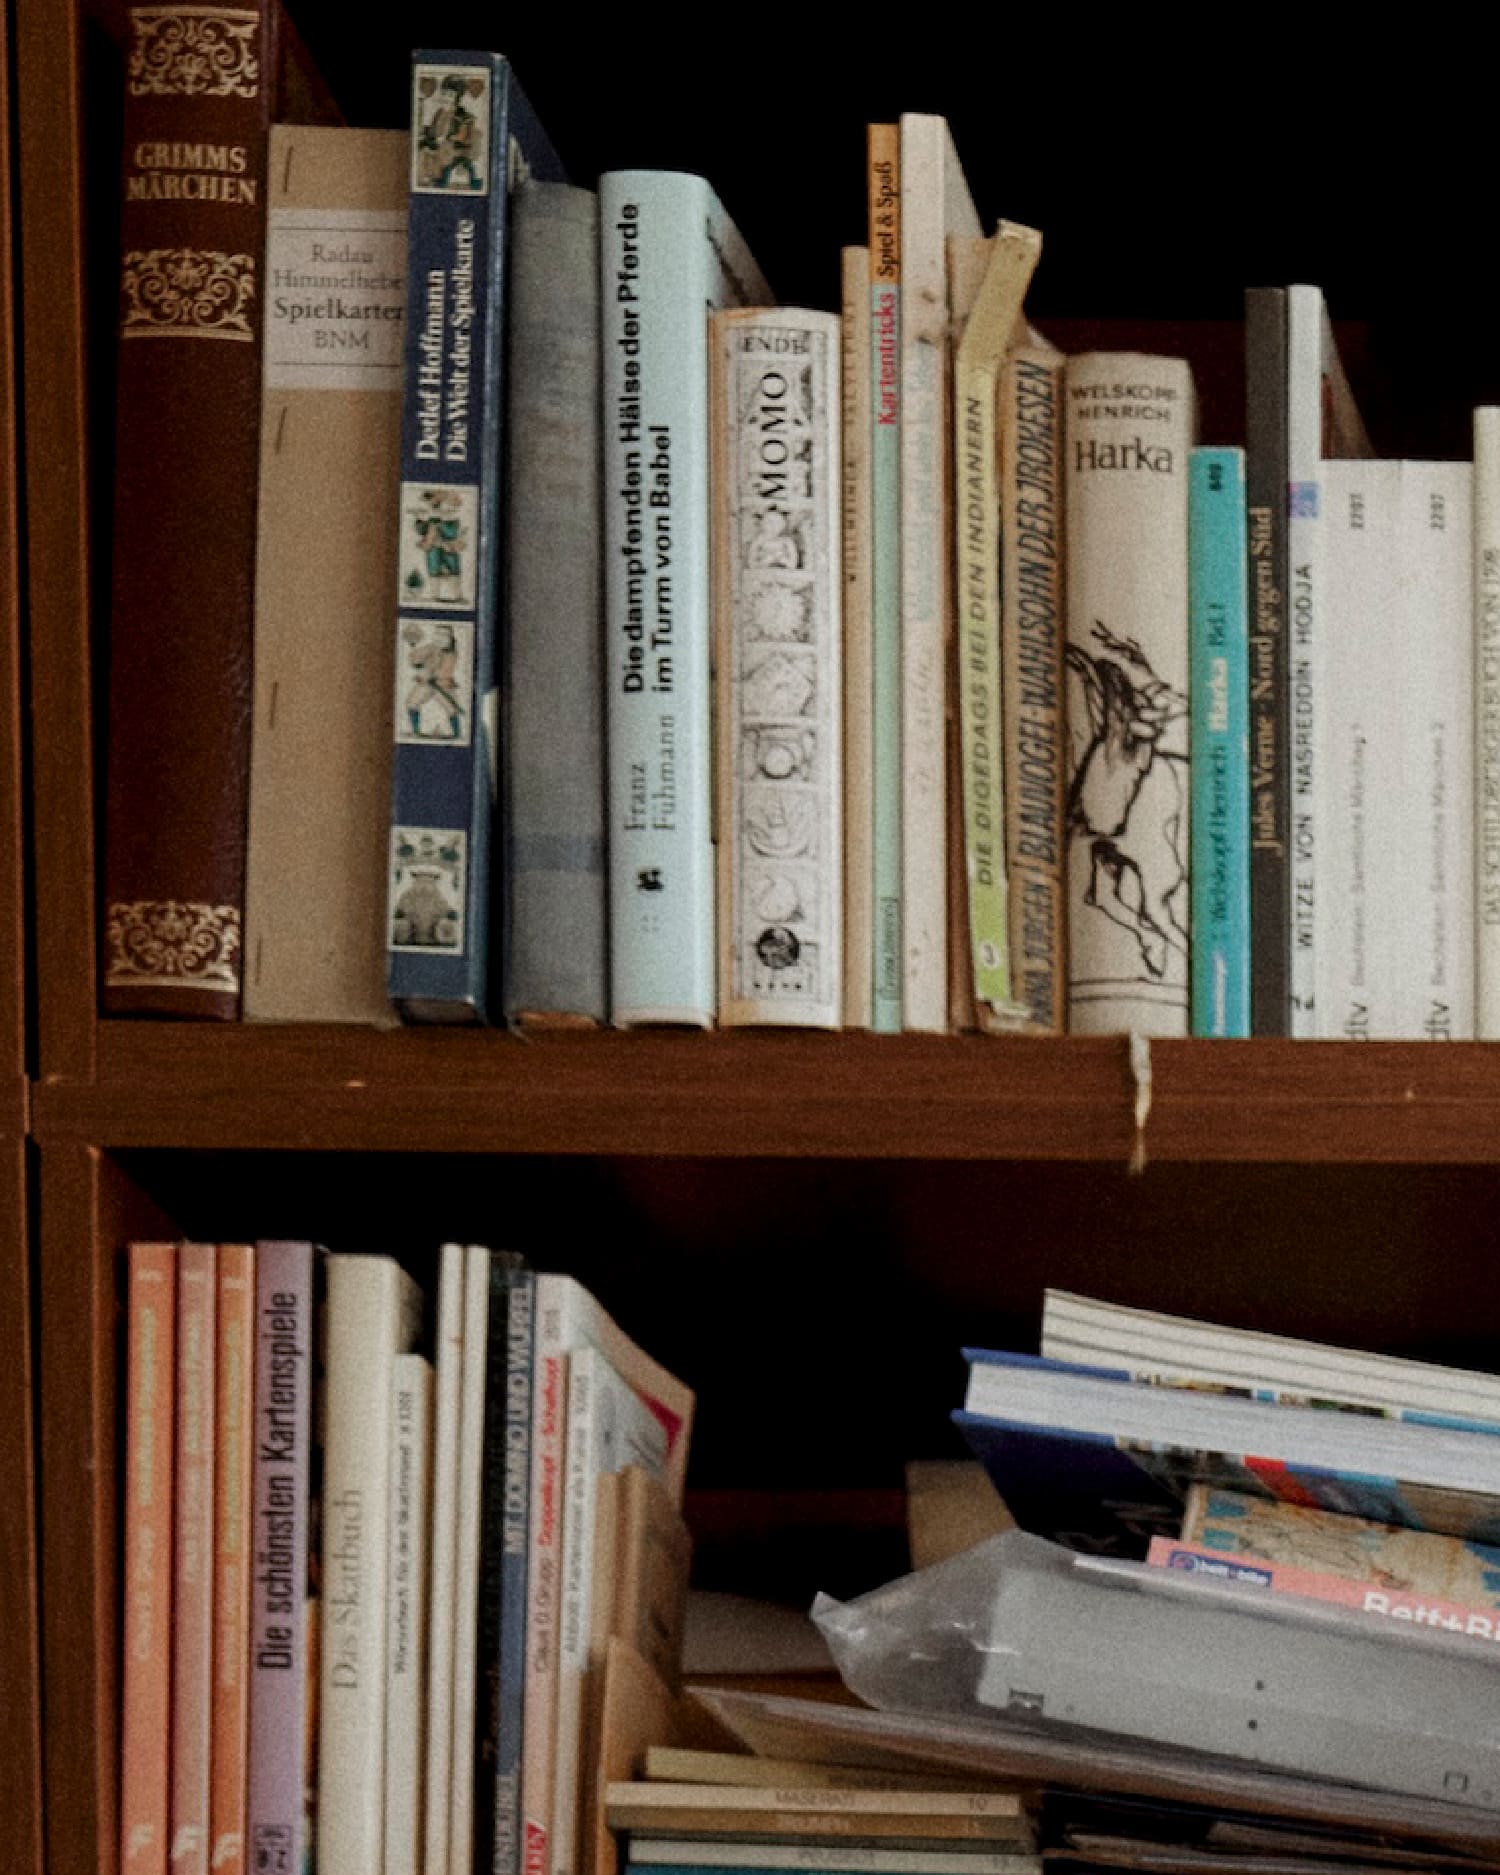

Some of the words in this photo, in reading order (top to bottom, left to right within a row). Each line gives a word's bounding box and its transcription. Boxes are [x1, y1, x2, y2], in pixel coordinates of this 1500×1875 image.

[134, 142, 248, 173] GRIMMS
[126, 173, 257, 205] MÄRCHEN
[448, 218, 477, 330] Spielkarte
[616, 203, 640, 303] Pferde
[876, 231, 898, 278] Spiel
[314, 330, 370, 350] BNM
[417, 269, 445, 385] Hoffmann
[446, 332, 471, 367] der
[618, 308, 641, 357] der
[874, 292, 897, 425] Kartentricks
[447, 367, 470, 420] Welt
[619, 361, 642, 443] Hälse
[414, 392, 442, 460] Detlef
[444, 421, 470, 462] Die
[759, 371, 788, 499] MOMO
[648, 424, 671, 509] Babel
[965, 396, 986, 555] INDIANERN
[1073, 437, 1174, 475] Harka
[620, 451, 647, 642] dampfenden
[652, 514, 671, 569] von
[1016, 498, 1056, 558] DER
[1249, 507, 1274, 557] Süd
[651, 575, 673, 651] Turm
[967, 565, 986, 613] DEN
[1293, 563, 1314, 645] HODJA
[622, 645, 645, 693] Die
[651, 655, 673, 693] im
[968, 631, 988, 675] BEI
[1250, 636, 1274, 701] Nord
[970, 683, 992, 832] DIGEDAGS
[1254, 715, 1275, 787] Verne
[972, 839, 993, 887] DIE
[1294, 815, 1314, 863] VON
[259, 1291, 304, 1463] Kartenspiele
[256, 1475, 295, 1615] schönsten
[256, 1626, 295, 1671] Die
[330, 1634, 360, 1690] Das
